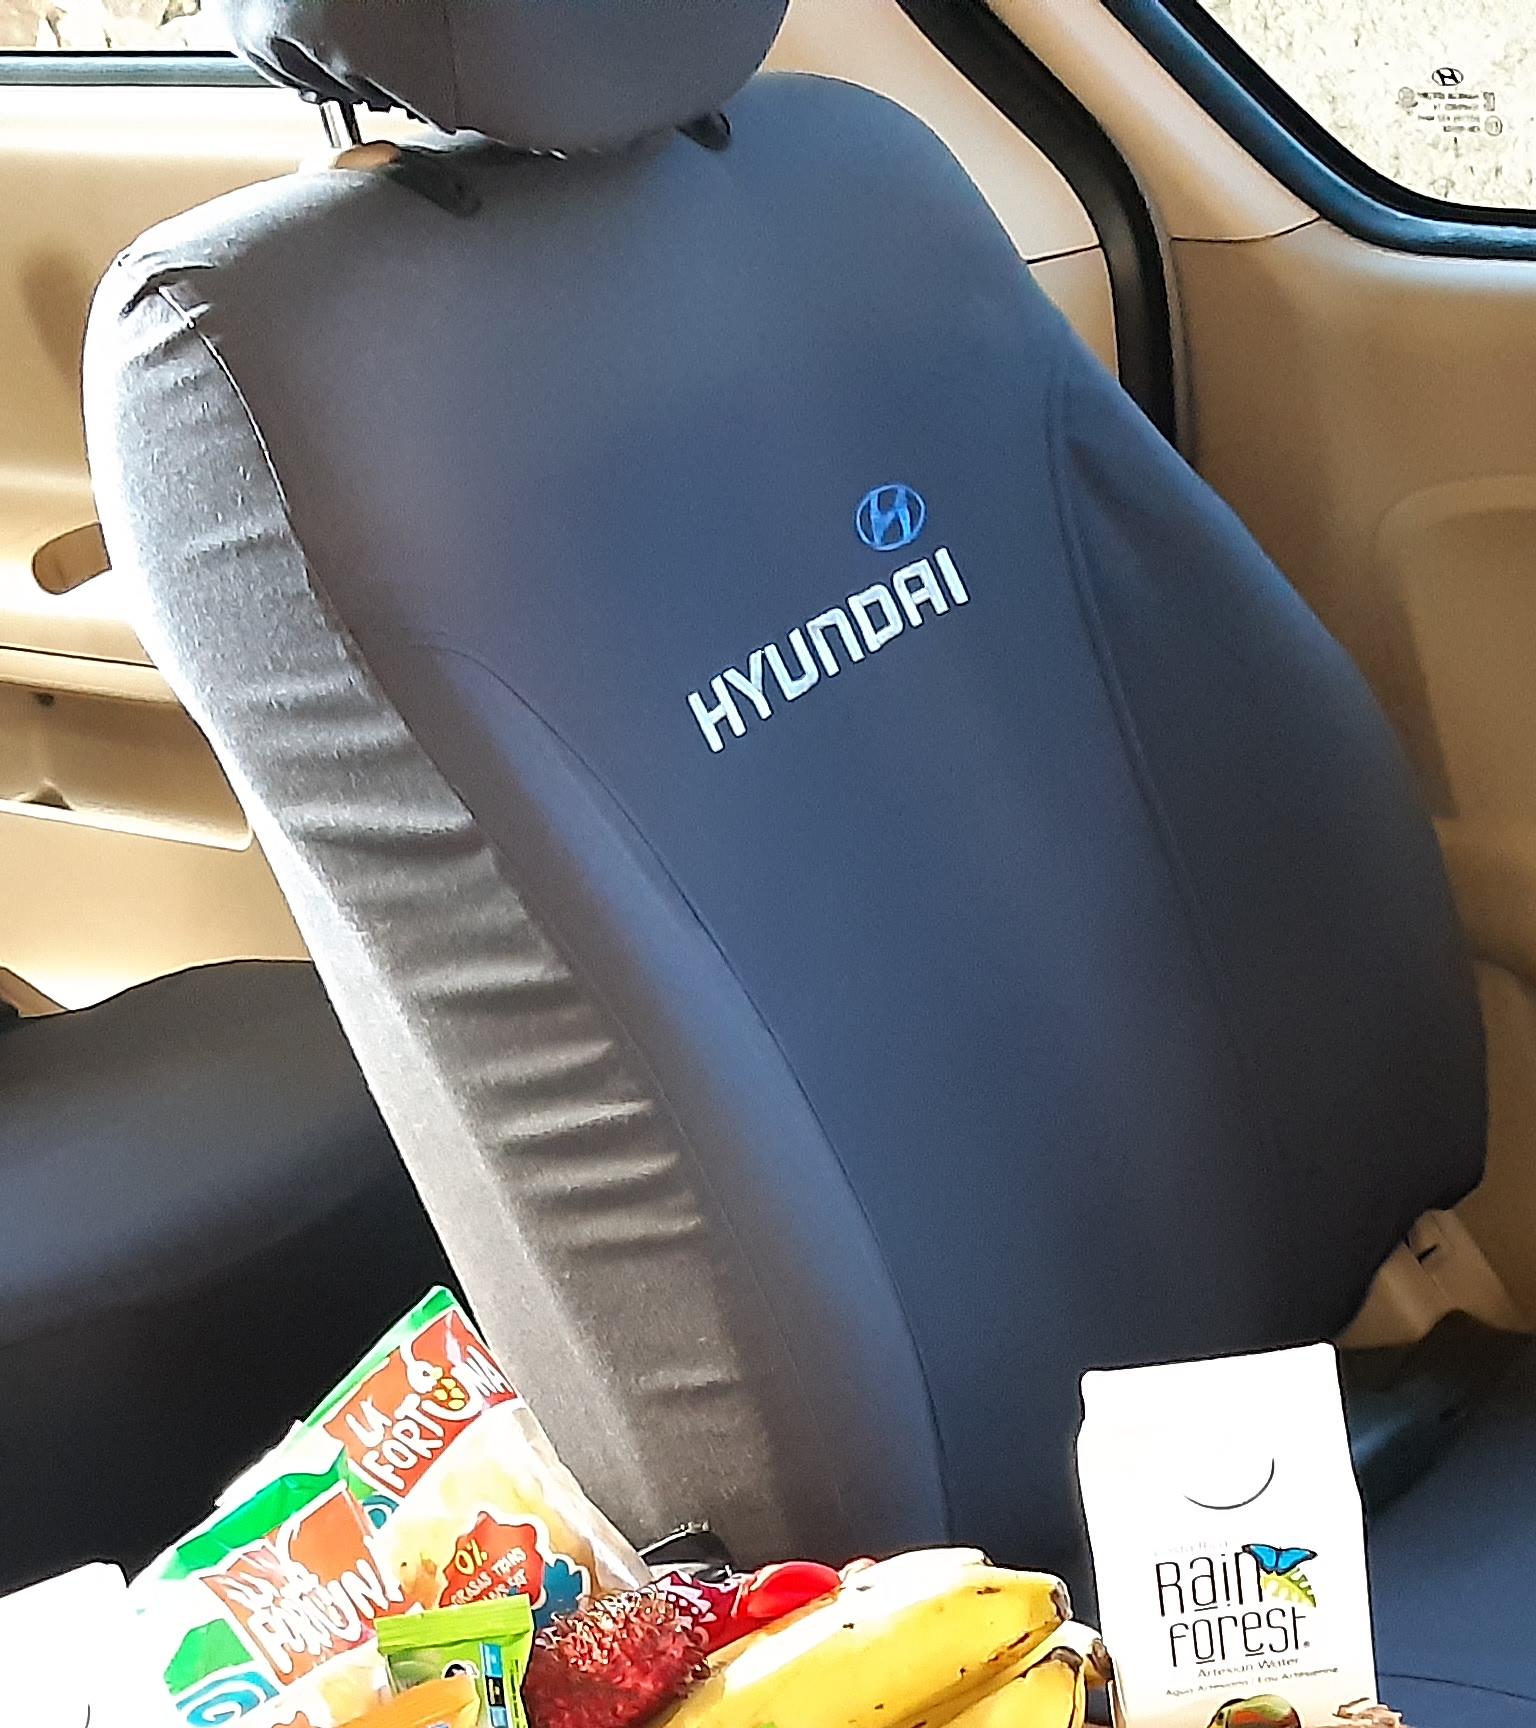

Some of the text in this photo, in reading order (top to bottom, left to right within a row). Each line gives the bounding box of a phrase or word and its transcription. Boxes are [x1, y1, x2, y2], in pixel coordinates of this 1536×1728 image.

[687, 547, 969, 752] HYUNDAI
[344, 1393, 394, 1448] LA
[361, 1343, 516, 1490] FORTUNA
[454, 1539, 489, 1576] 0%
[1155, 1551, 1264, 1617] Rain
